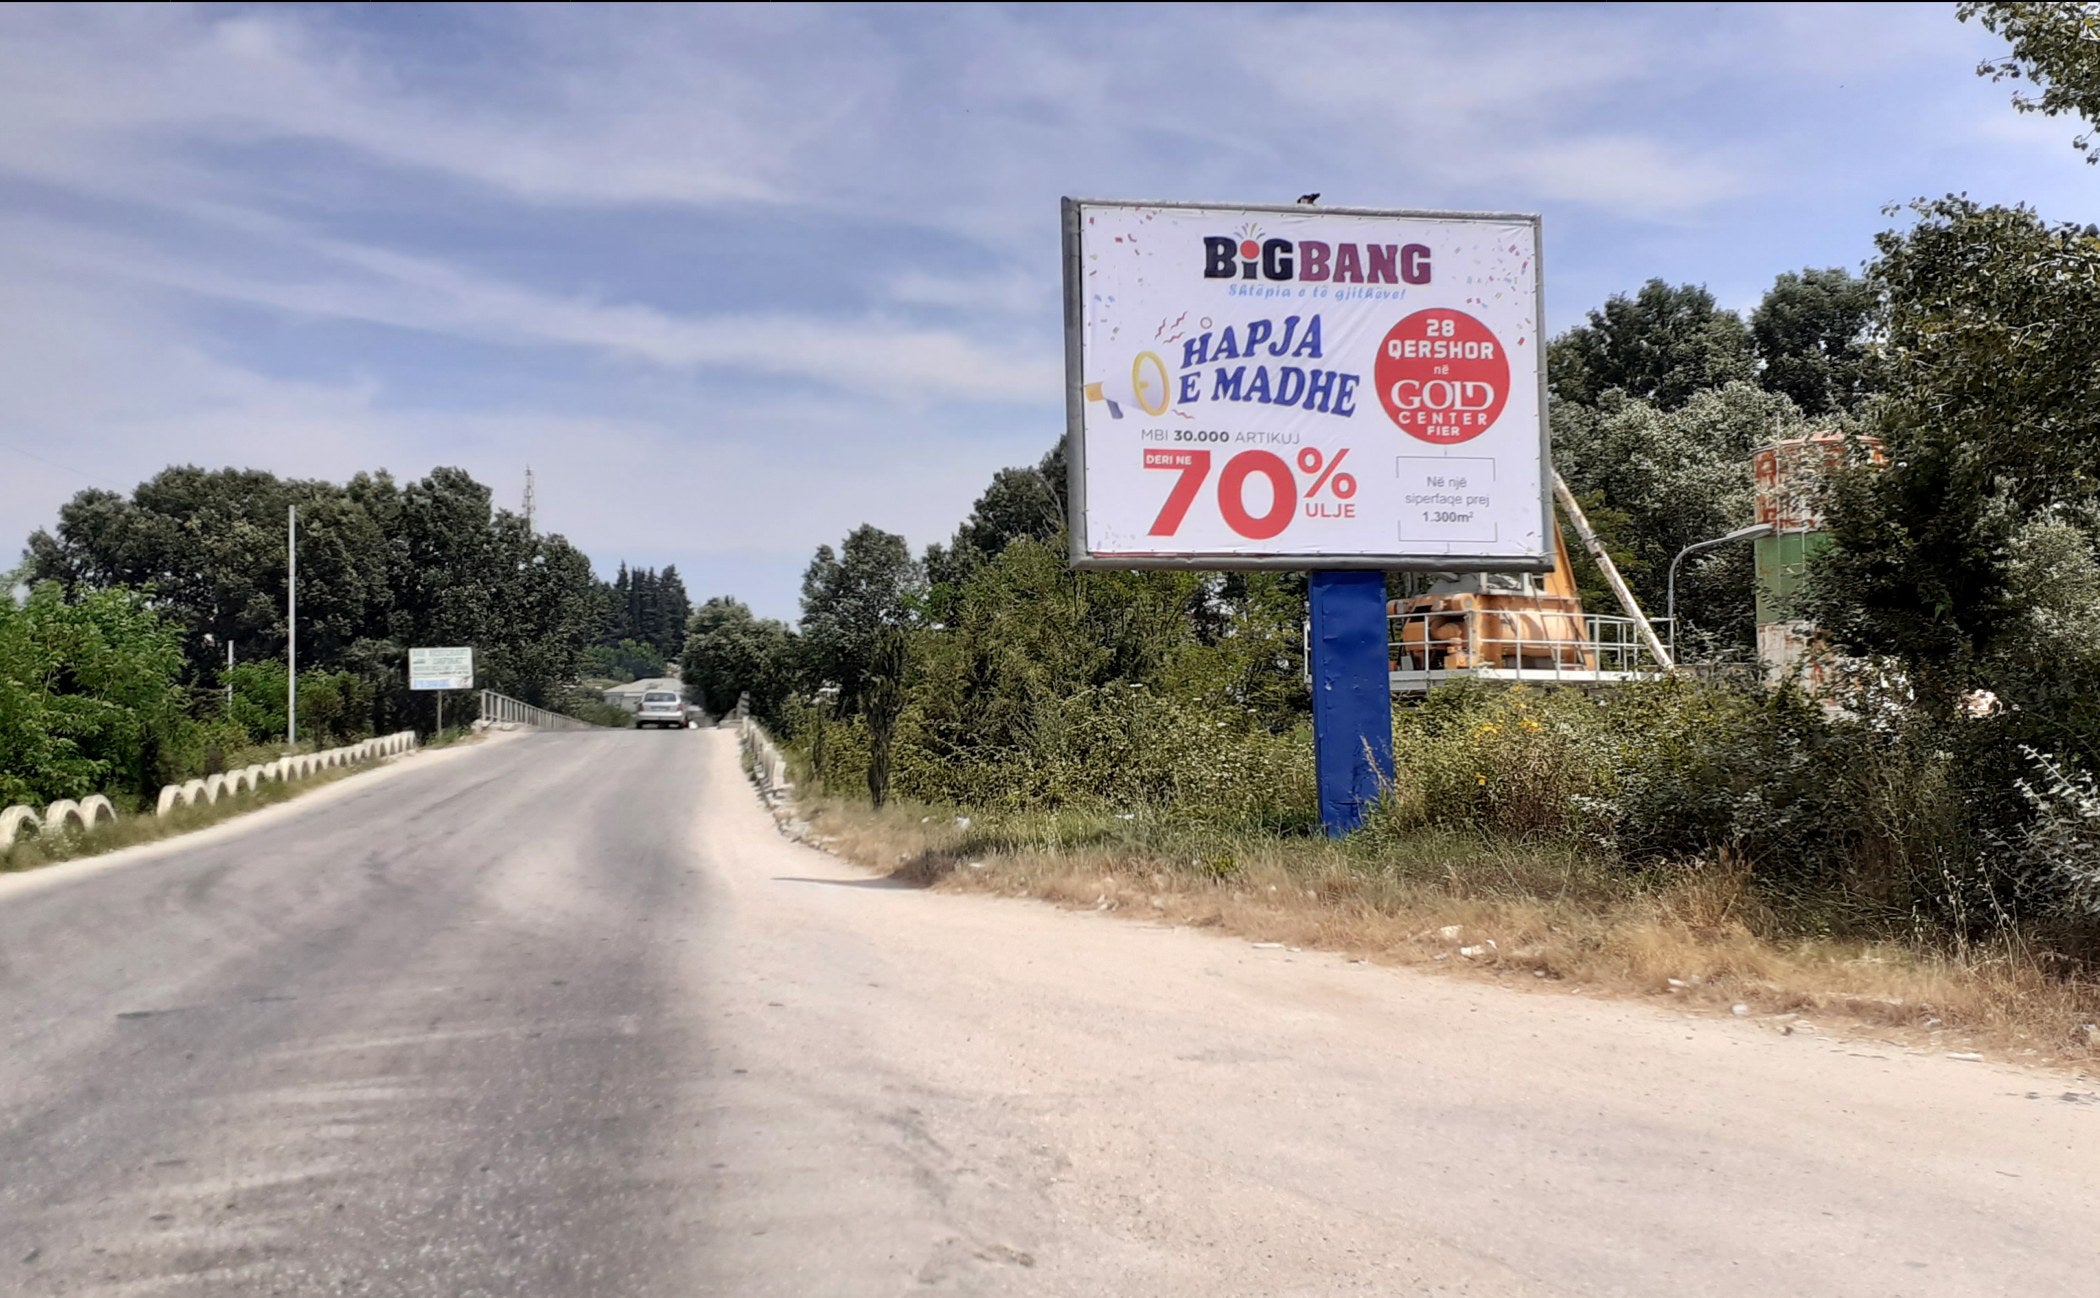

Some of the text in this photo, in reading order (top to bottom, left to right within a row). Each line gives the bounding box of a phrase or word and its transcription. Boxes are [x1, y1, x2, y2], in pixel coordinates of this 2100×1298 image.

[1298, 287, 1306, 297] e
[1426, 319, 1455, 337] 28
[1180, 314, 1323, 369] HAPJA
[1388, 339, 1494, 360] QERSHOR
[1433, 364, 1449, 374] në
[1177, 365, 1360, 418] E MADHE
[1391, 379, 1495, 410] GOLD
[1398, 411, 1487, 425] CENTER
[1141, 429, 1300, 445] MBI 30.000 ARTIKUJ
[1427, 426, 1460, 436] FIER
[1146, 455, 1192, 465] DERI NE
[1426, 476, 1467, 490] Në një
[1405, 493, 1489, 507] siperfaqe prej
[1305, 503, 1355, 518] ULJE
